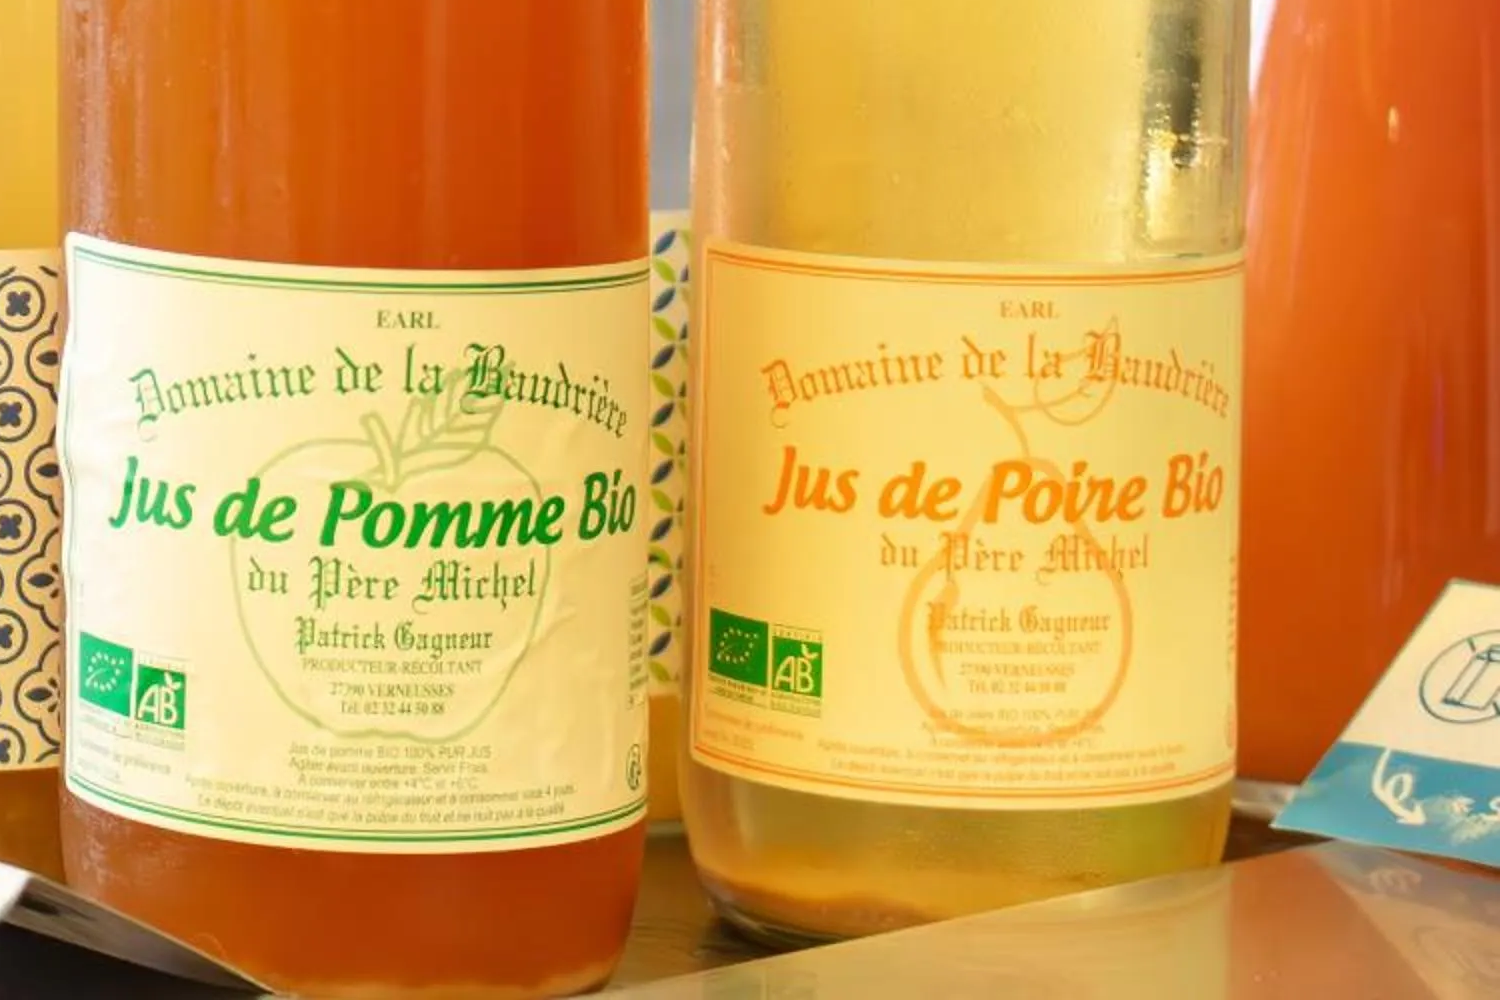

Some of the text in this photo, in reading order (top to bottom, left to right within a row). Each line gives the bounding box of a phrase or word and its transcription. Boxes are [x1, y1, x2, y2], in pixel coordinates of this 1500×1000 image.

[376, 310, 441, 329] EARL
[1000, 300, 1060, 319] EARL
[129, 341, 628, 442] Domaine de la Baudrière
[761, 343, 944, 430] Domaine
[960, 335, 1006, 381] de
[1026, 332, 1063, 381] la
[108, 456, 638, 549] Jus de Pomme Bio
[762, 445, 1225, 525] Jus de Poire Bio
[880, 531, 1150, 586] du Père Michel
[247, 555, 537, 615] du Père Michel
[293, 614, 494, 660] Patrick Gagneur
[1018, 604, 1112, 641] Gagneur
[774, 655, 814, 693] AB
[138, 684, 178, 724] AB
